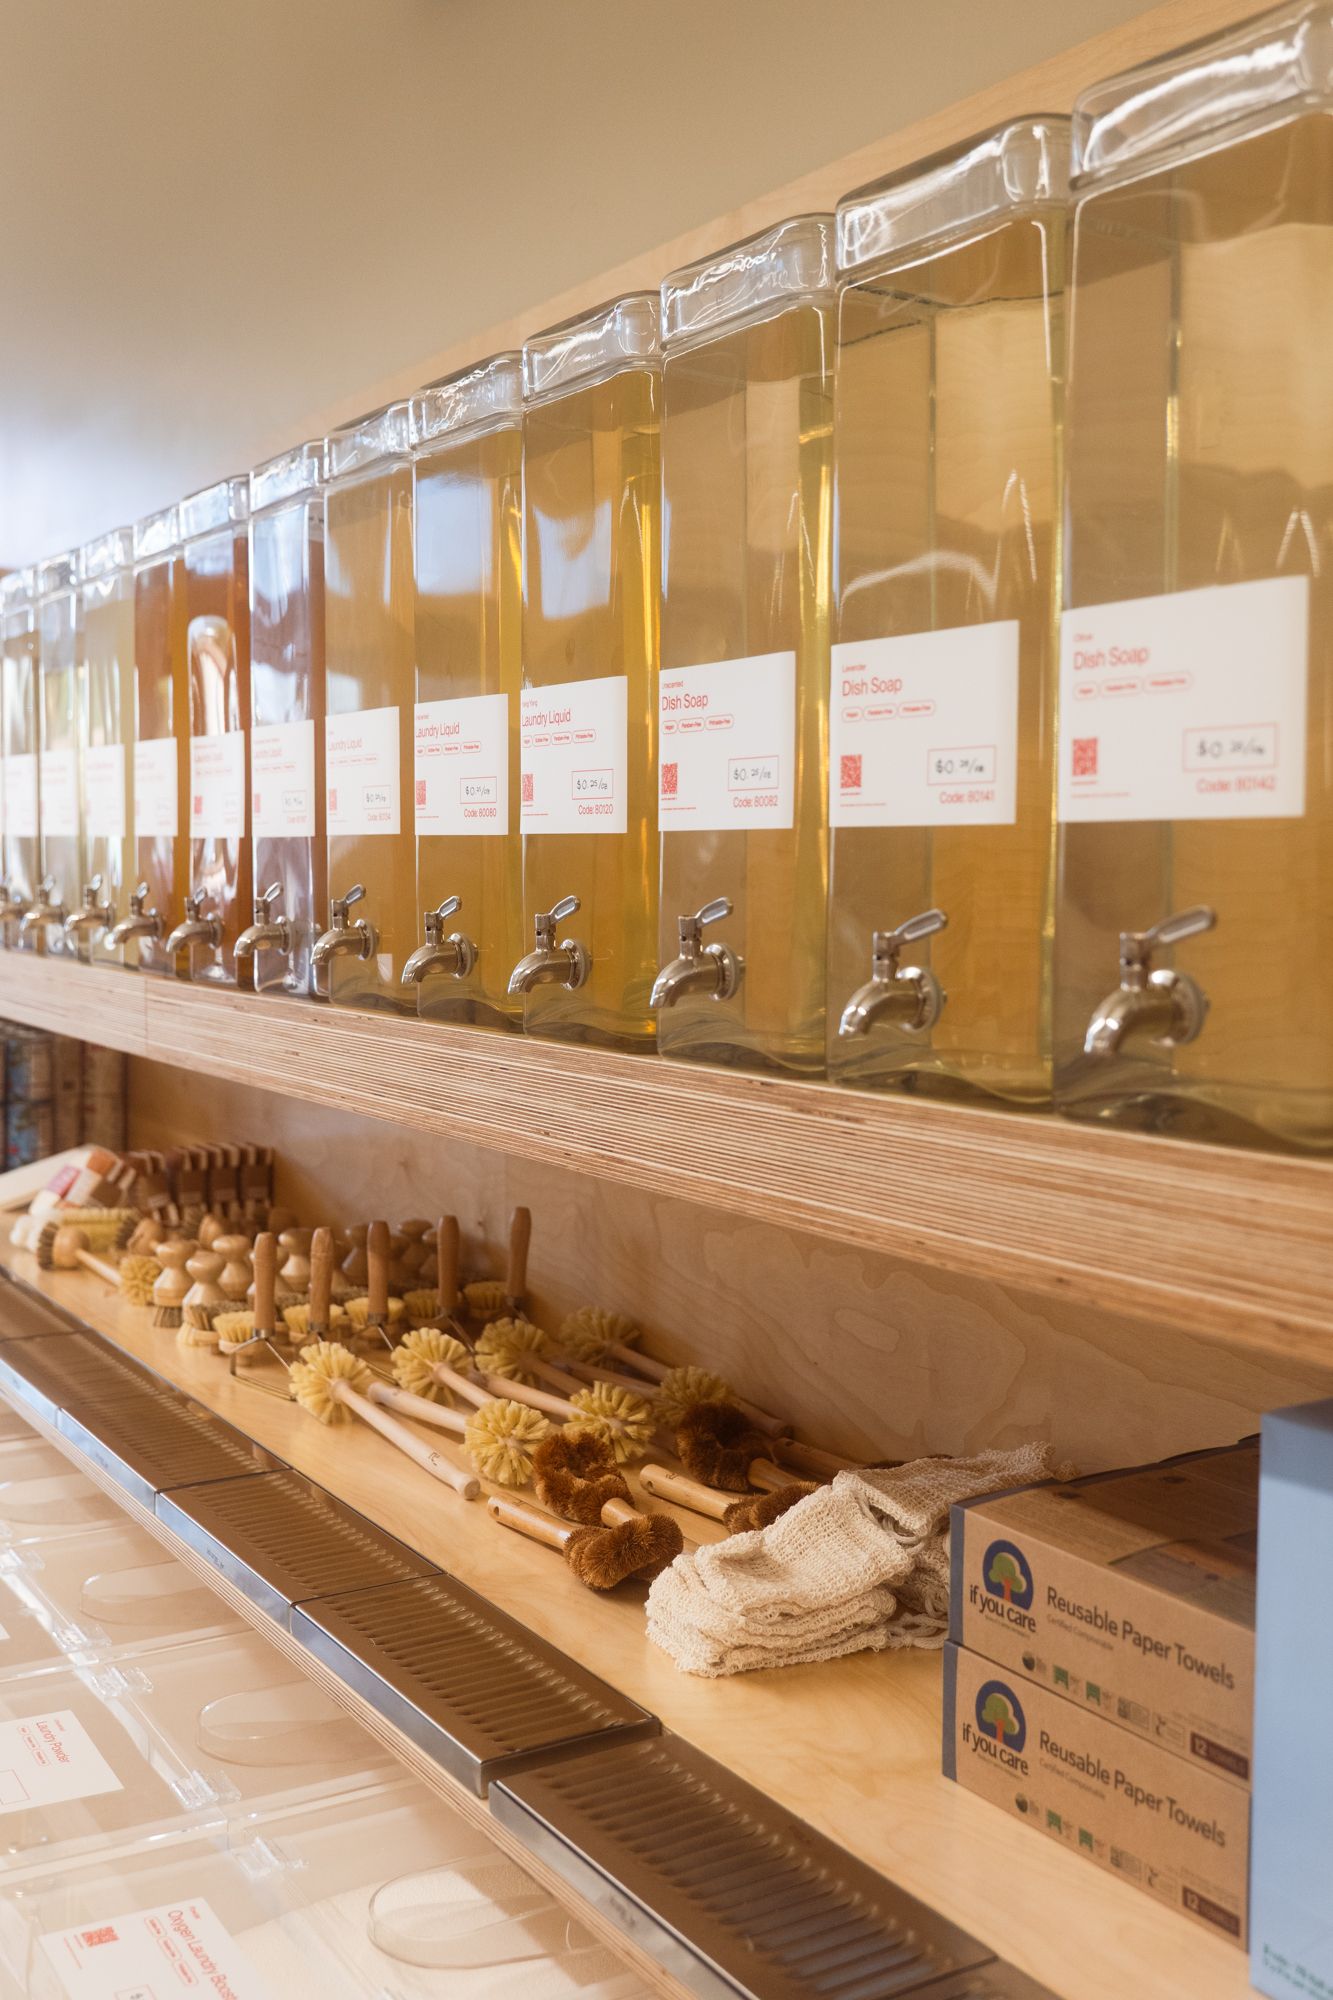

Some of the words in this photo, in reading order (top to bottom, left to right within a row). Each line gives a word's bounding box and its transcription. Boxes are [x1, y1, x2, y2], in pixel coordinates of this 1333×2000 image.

[1074, 650, 1105, 670] Dish
[1109, 647, 1149, 667] Soap
[842, 679, 868, 696] Dish
[871, 677, 903, 694] Soap
[662, 695, 682, 711] Dish
[684, 693, 709, 710] Soap
[522, 713, 548, 728] Laundry
[549, 708, 571, 727] Liquid
[440, 722, 460, 738] Liquid
[578, 804, 594, 816] Code:
[969, 1584, 979, 1603] if
[979, 1592, 1004, 1618] you
[1006, 1606, 1037, 1633] care
[1047, 1585, 1118, 1637] Reusable
[1121, 1620, 1172, 1660] Paper
[1174, 1641, 1235, 1690] Towels
[962, 1722, 972, 1743] if
[972, 1731, 998, 1759] you
[999, 1747, 1029, 1776] care
[1040, 1730, 1110, 1785] Reusable
[1114, 1769, 1164, 1812] Paper
[1166, 1795, 1226, 1849] Towels
[187, 1939, 219, 1975] Laundry
